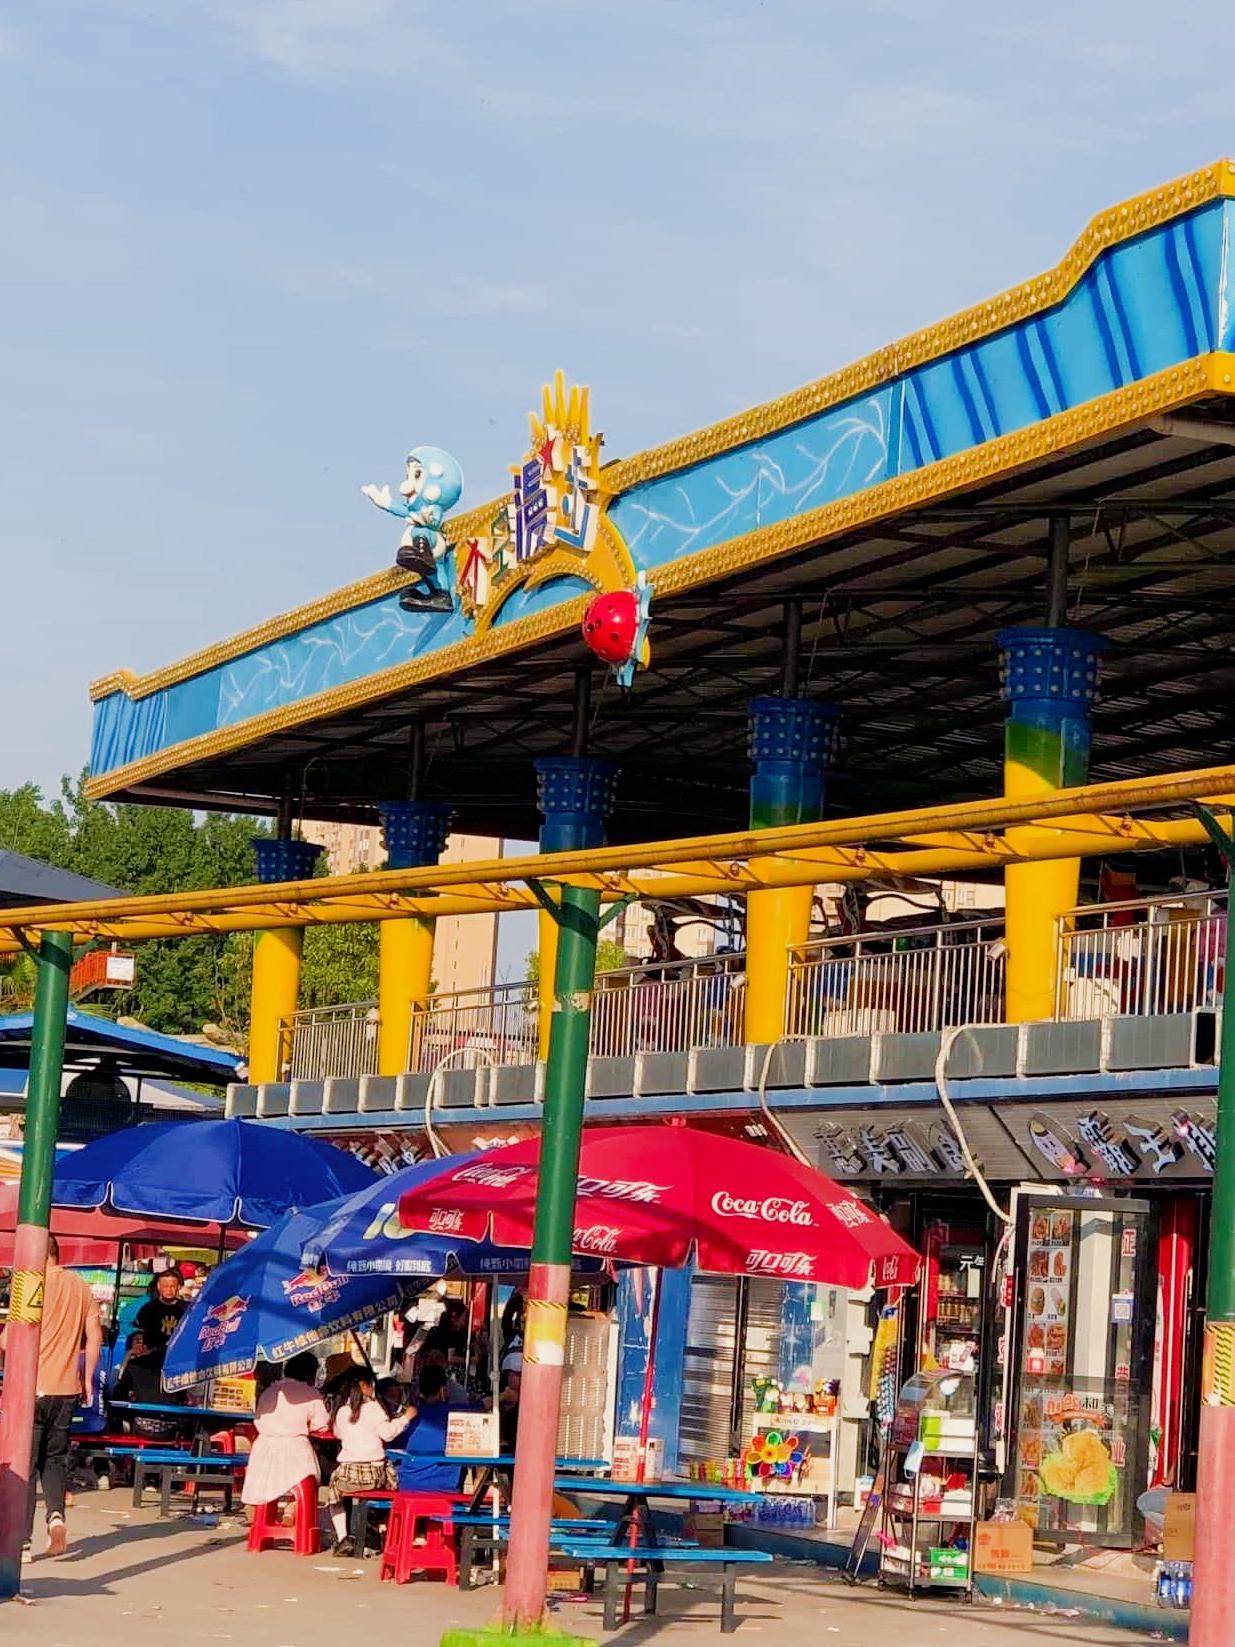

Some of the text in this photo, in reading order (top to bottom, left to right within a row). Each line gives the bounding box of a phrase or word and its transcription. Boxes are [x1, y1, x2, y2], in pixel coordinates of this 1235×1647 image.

[576, 1175, 674, 1203] 口可乐
[428, 1207, 464, 1232] 可口可乐
[711, 1191, 814, 1226] Coca-Cola
[745, 1249, 818, 1275] 可口可乐
